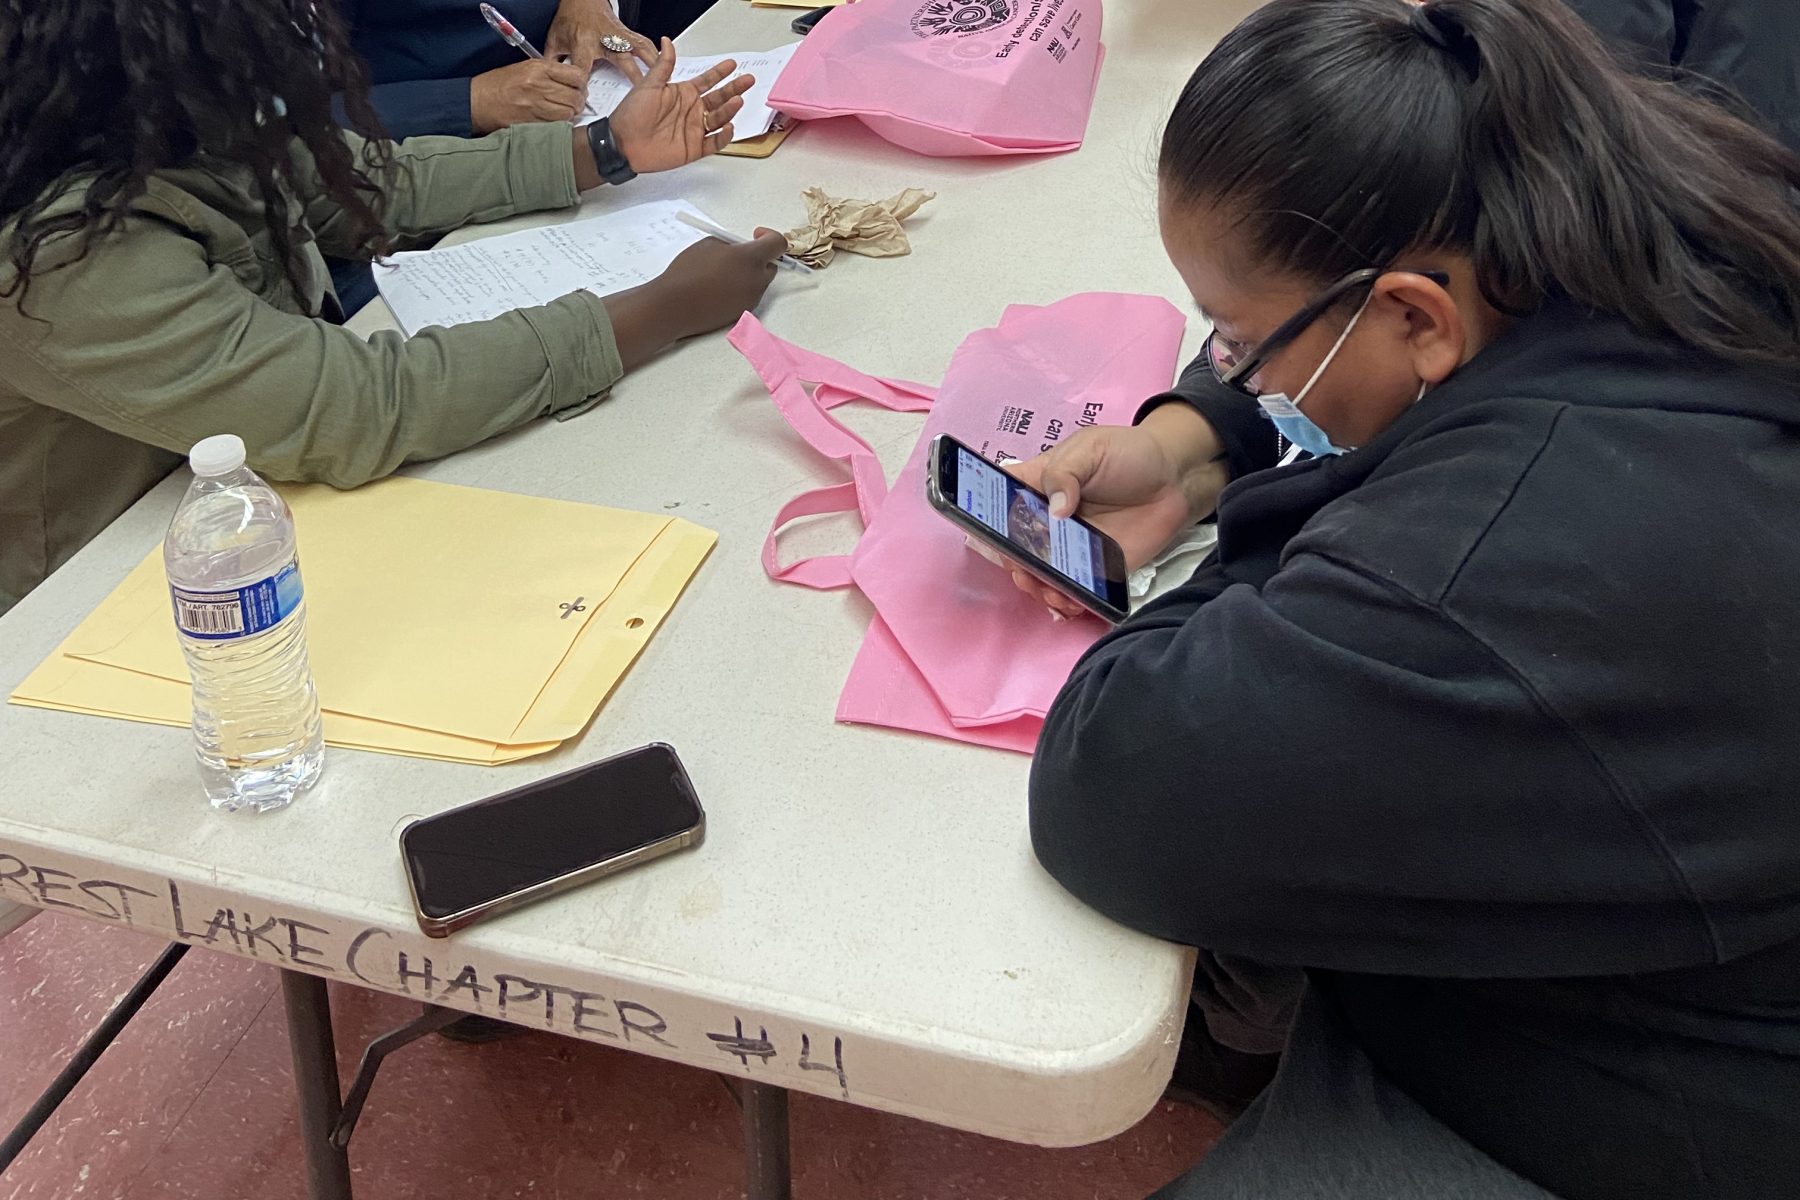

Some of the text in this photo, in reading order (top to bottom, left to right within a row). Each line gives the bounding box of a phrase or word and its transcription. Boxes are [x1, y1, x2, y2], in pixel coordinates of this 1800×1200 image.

[1029, 26, 1045, 42] can
[1039, 9, 1056, 28] save
[995, 39, 1020, 58] Early
[1046, 37, 1060, 54] NAU
[1003, 406, 1016, 432] ARIZONA
[1015, 409, 1034, 436] NAU
[1044, 419, 1063, 441] can
[168, 877, 335, 972] LAKE
[346, 926, 678, 1049] CHAPTER
